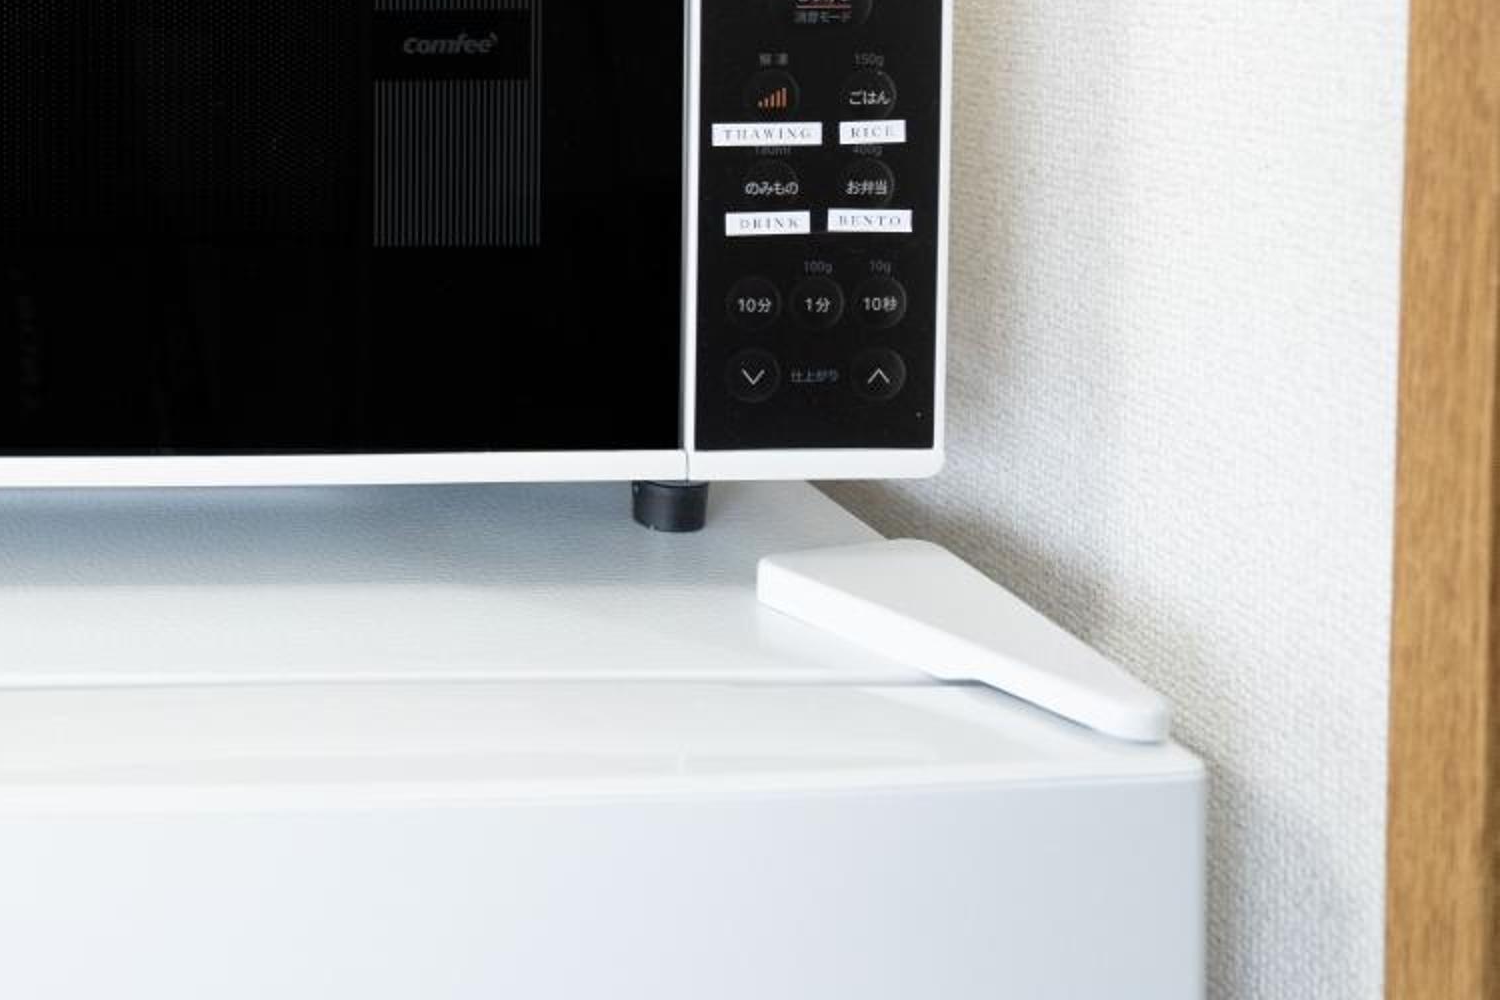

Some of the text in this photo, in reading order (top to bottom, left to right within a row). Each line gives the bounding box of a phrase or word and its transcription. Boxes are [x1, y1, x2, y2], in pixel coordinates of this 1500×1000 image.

[849, 89, 891, 105] ごはん
[724, 127, 812, 141] THAWING
[851, 126, 897, 139] RICE
[745, 181, 799, 195] のみもの
[846, 179, 888, 195] お弁当
[740, 217, 801, 230] DRINK
[839, 214, 901, 227] BENTO
[737, 297, 772, 313] 10分
[804, 297, 831, 313] 1分
